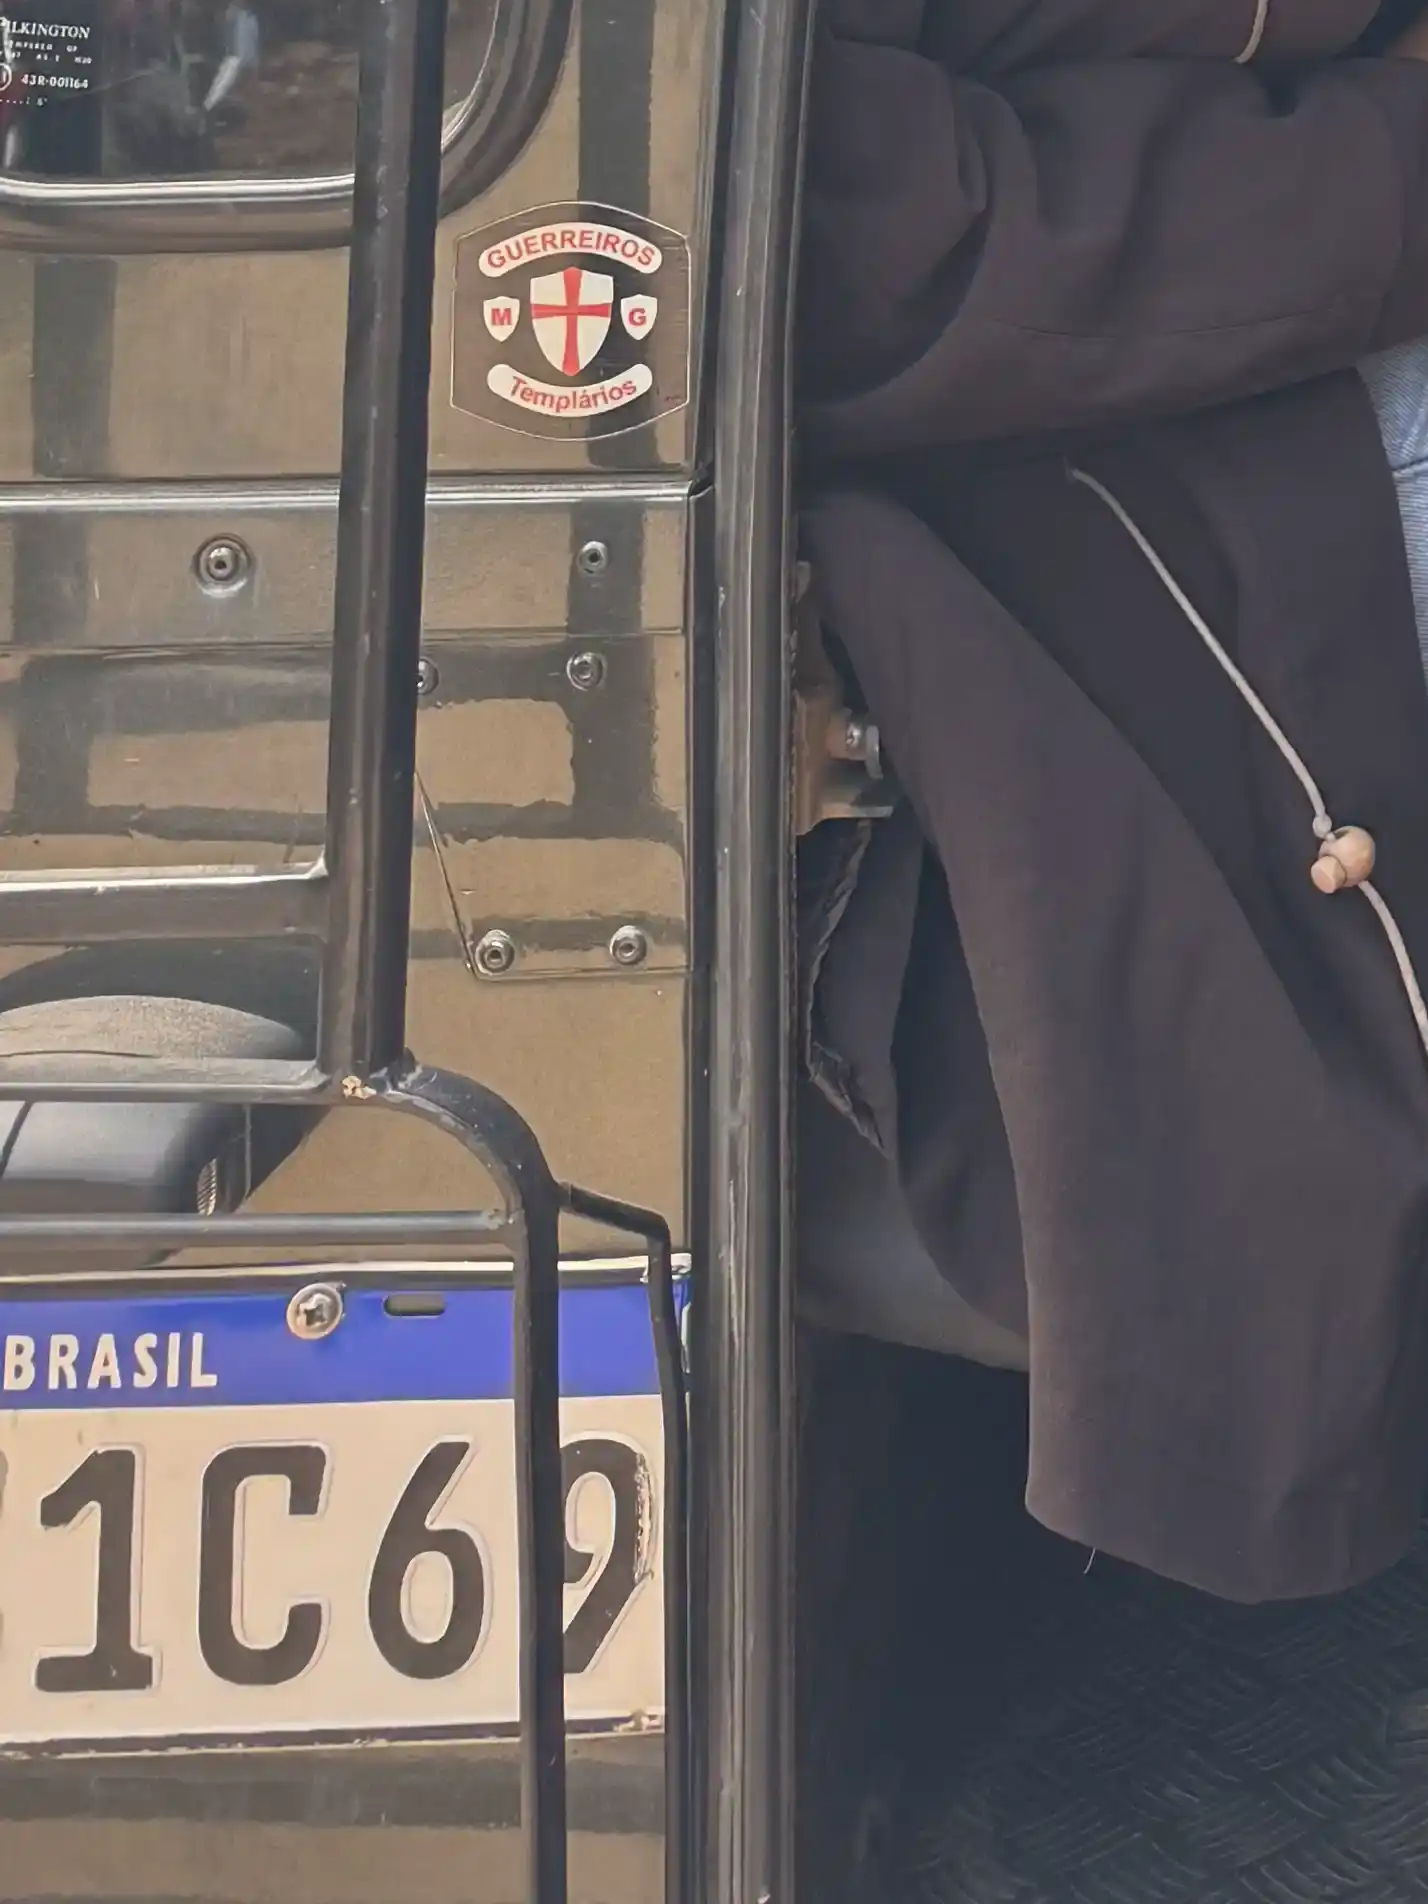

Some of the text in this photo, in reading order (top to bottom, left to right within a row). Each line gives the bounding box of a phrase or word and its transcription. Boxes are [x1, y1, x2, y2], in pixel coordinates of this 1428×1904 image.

[487, 229, 655, 269] GUERREIROS
[491, 307, 647, 326] M G
[508, 375, 637, 413] Templários
[3, 1332, 218, 1390] BRASIL
[0, 1438, 650, 1693] 1C69
